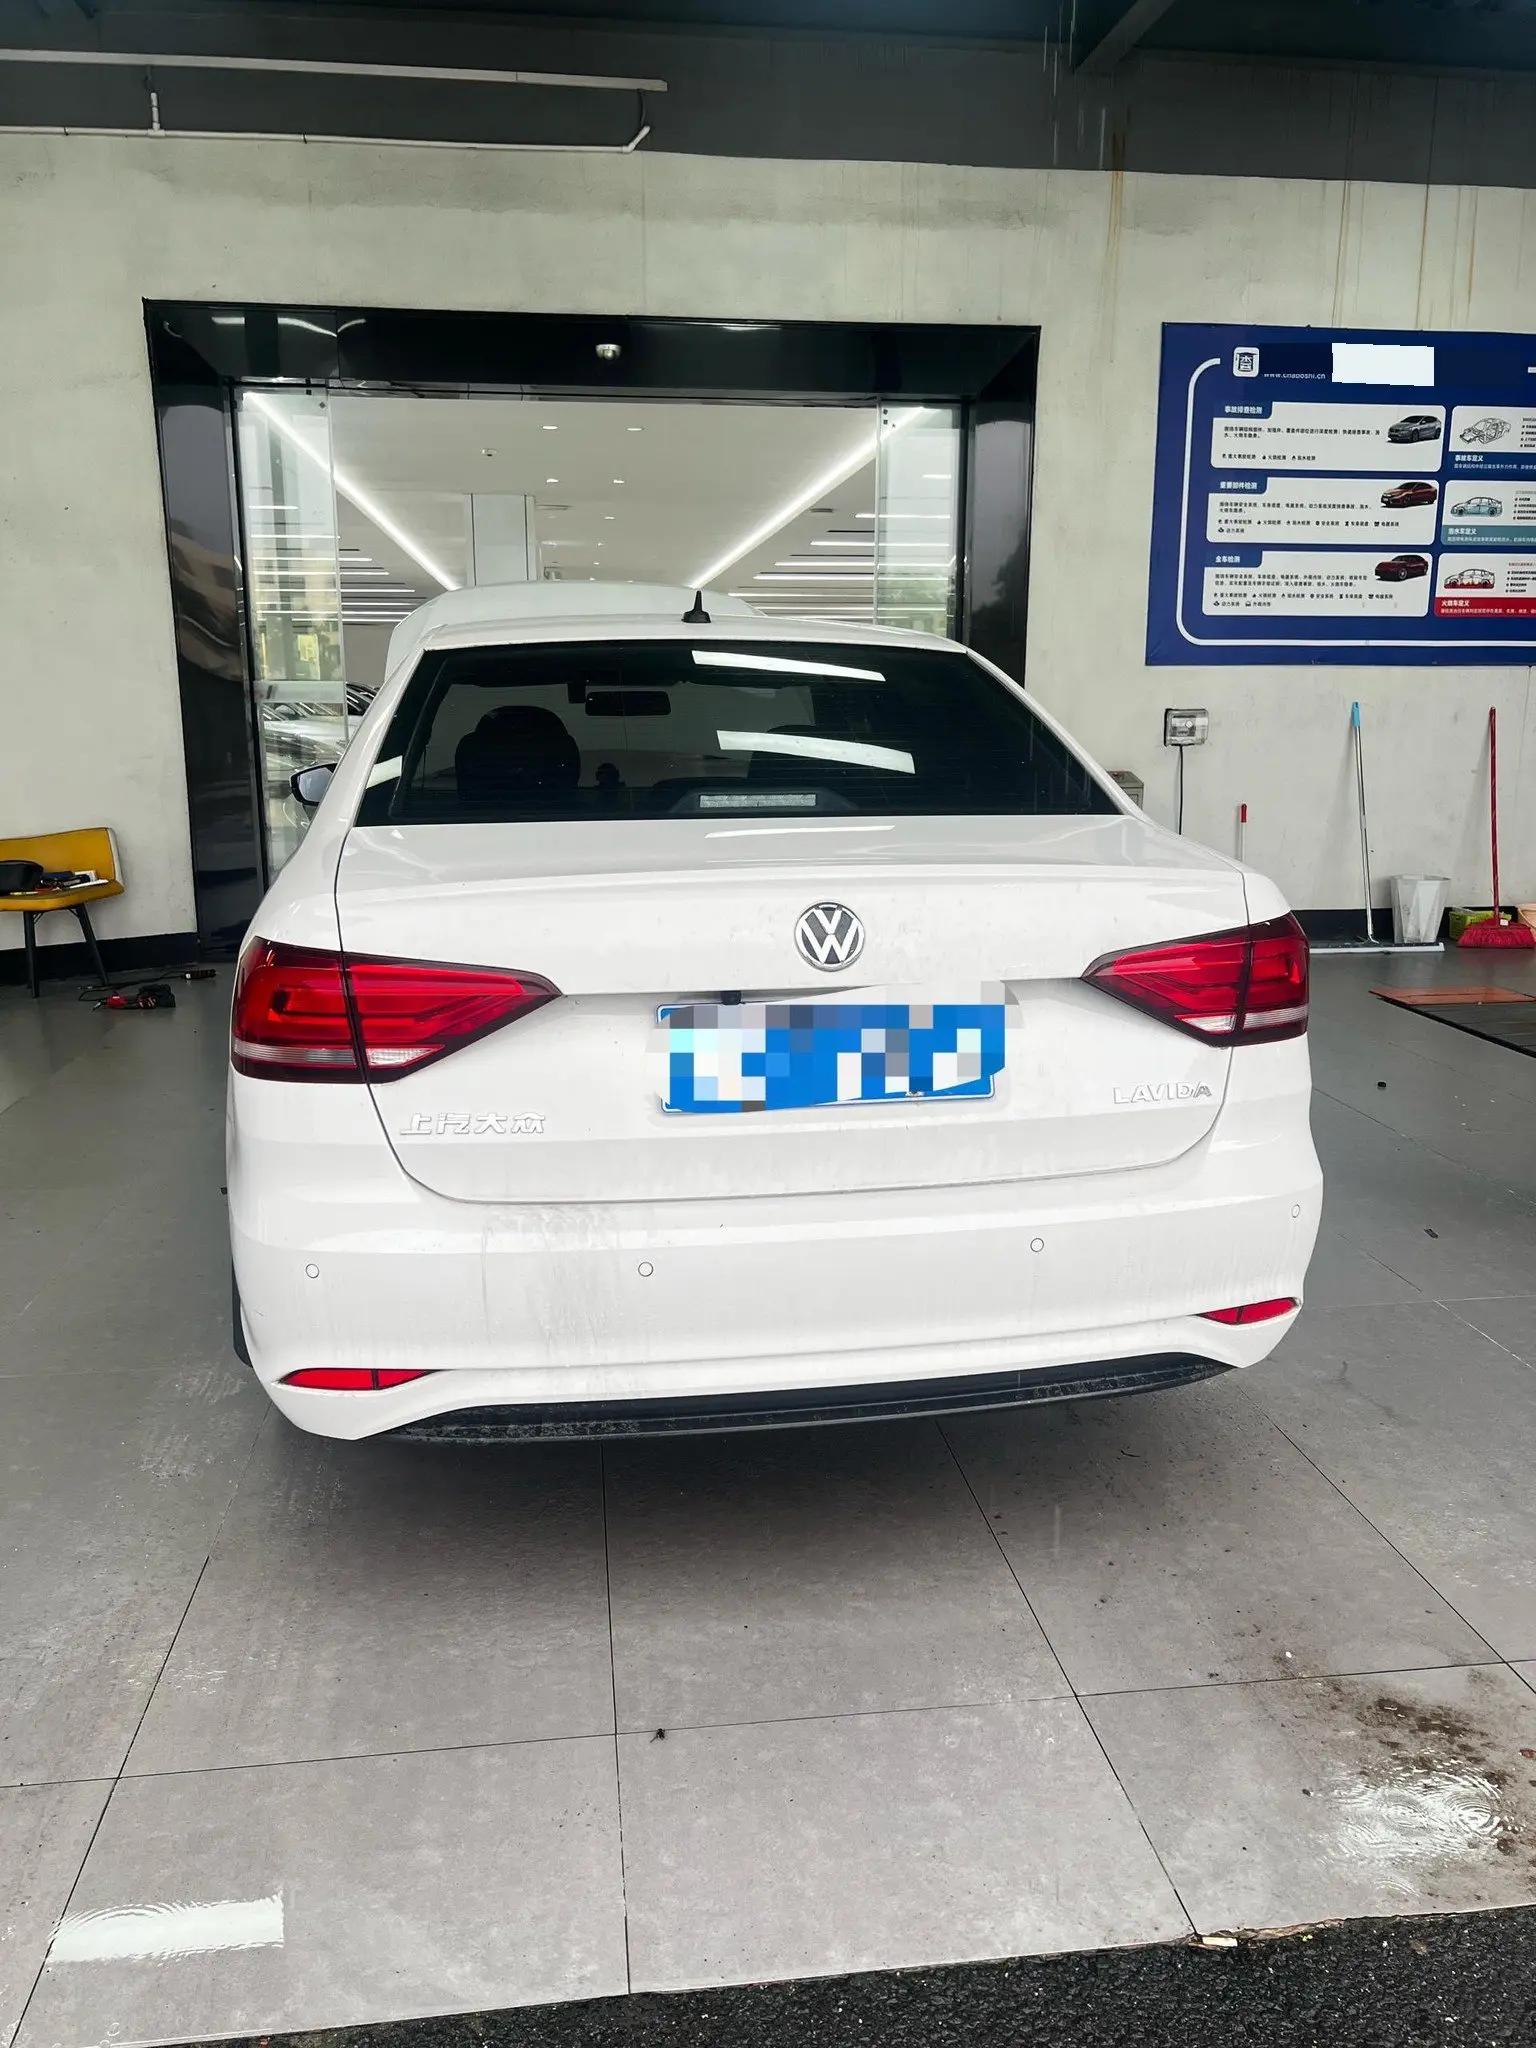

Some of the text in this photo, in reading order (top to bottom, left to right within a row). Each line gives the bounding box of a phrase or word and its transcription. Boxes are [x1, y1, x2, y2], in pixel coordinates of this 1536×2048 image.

[1112, 1081, 1212, 1105] LAVIDA
[399, 1112, 546, 1135] 上汽大众
